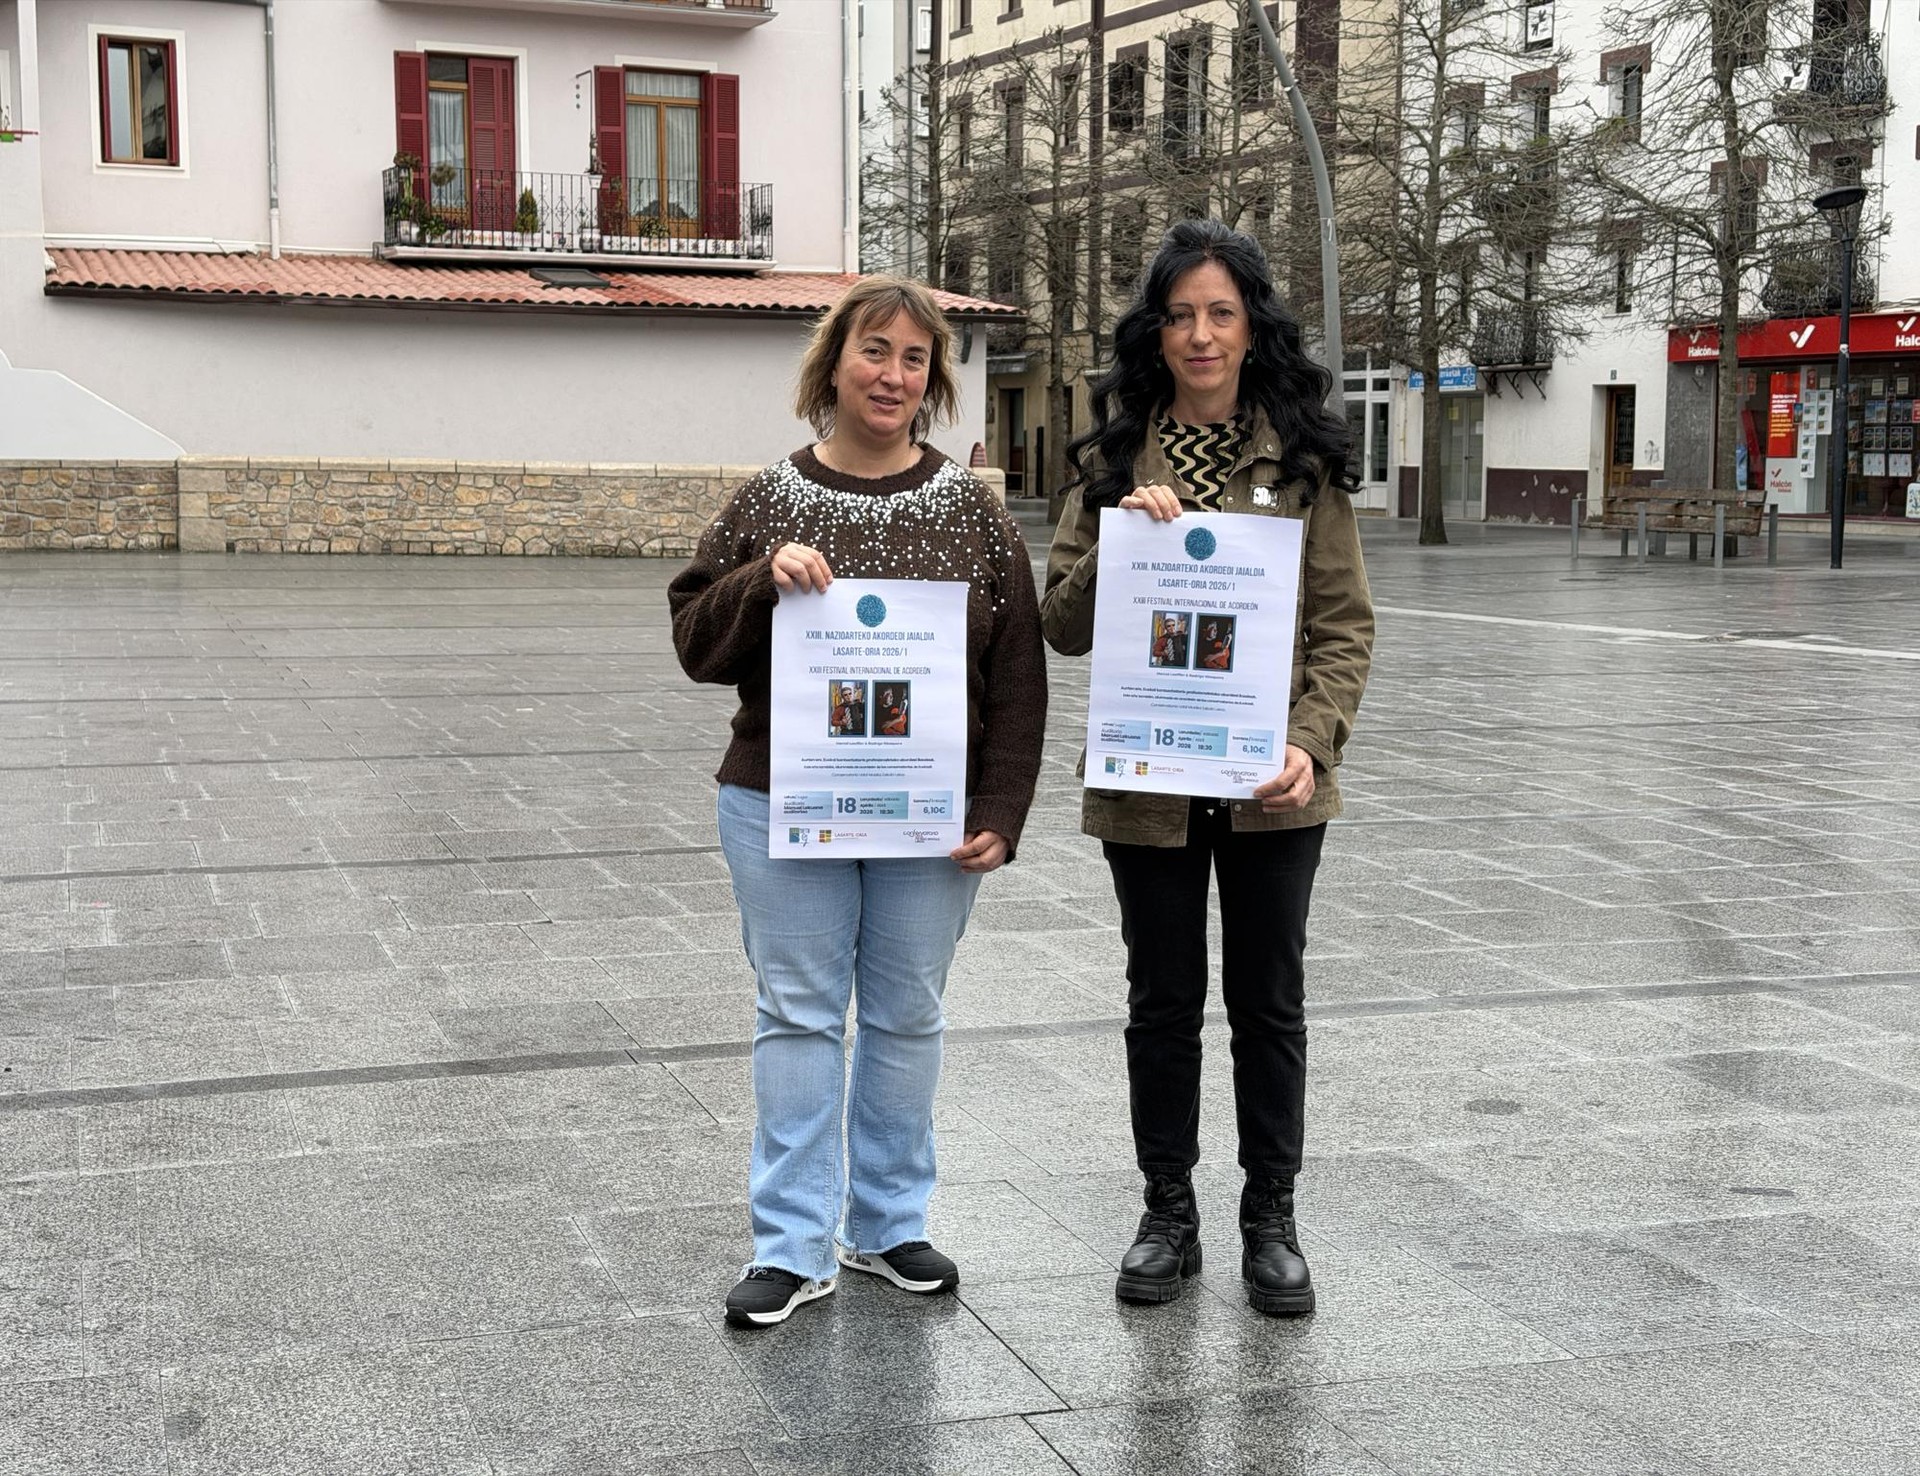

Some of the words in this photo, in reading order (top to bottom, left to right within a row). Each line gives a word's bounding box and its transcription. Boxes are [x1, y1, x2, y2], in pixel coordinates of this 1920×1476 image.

[1688, 345, 1711, 357] Halcón
[1770, 479, 1792, 487] Halcón
[1151, 562, 1198, 573] NAZIOARTEKO
[1199, 564, 1234, 575] AKORDEOI
[1234, 566, 1265, 577] JAIALDIA
[1157, 578, 1207, 589] LASARTE-ORIA
[1146, 597, 1173, 606] FESTIVAL
[1174, 598, 1217, 608] INTERNACIONAL
[1219, 601, 1227, 609] DE
[1228, 600, 1259, 610] ACORDEÓN
[825, 630, 871, 640] NAZIOARTEKO
[872, 631, 905, 641] AKORDEOI
[906, 631, 935, 641] JAIALDIA
[832, 646, 881, 656] LASARTE-ORIA
[822, 666, 848, 675] FESTIVAL
[849, 666, 892, 675] INTERNACIONAL
[893, 667, 901, 675] DE
[902, 666, 931, 675] ACORDEÓN
[1154, 728, 1175, 746] 18
[1242, 745, 1266, 754] 6,10€
[836, 797, 857, 814] 18
[923, 806, 946, 815] 6,10€
